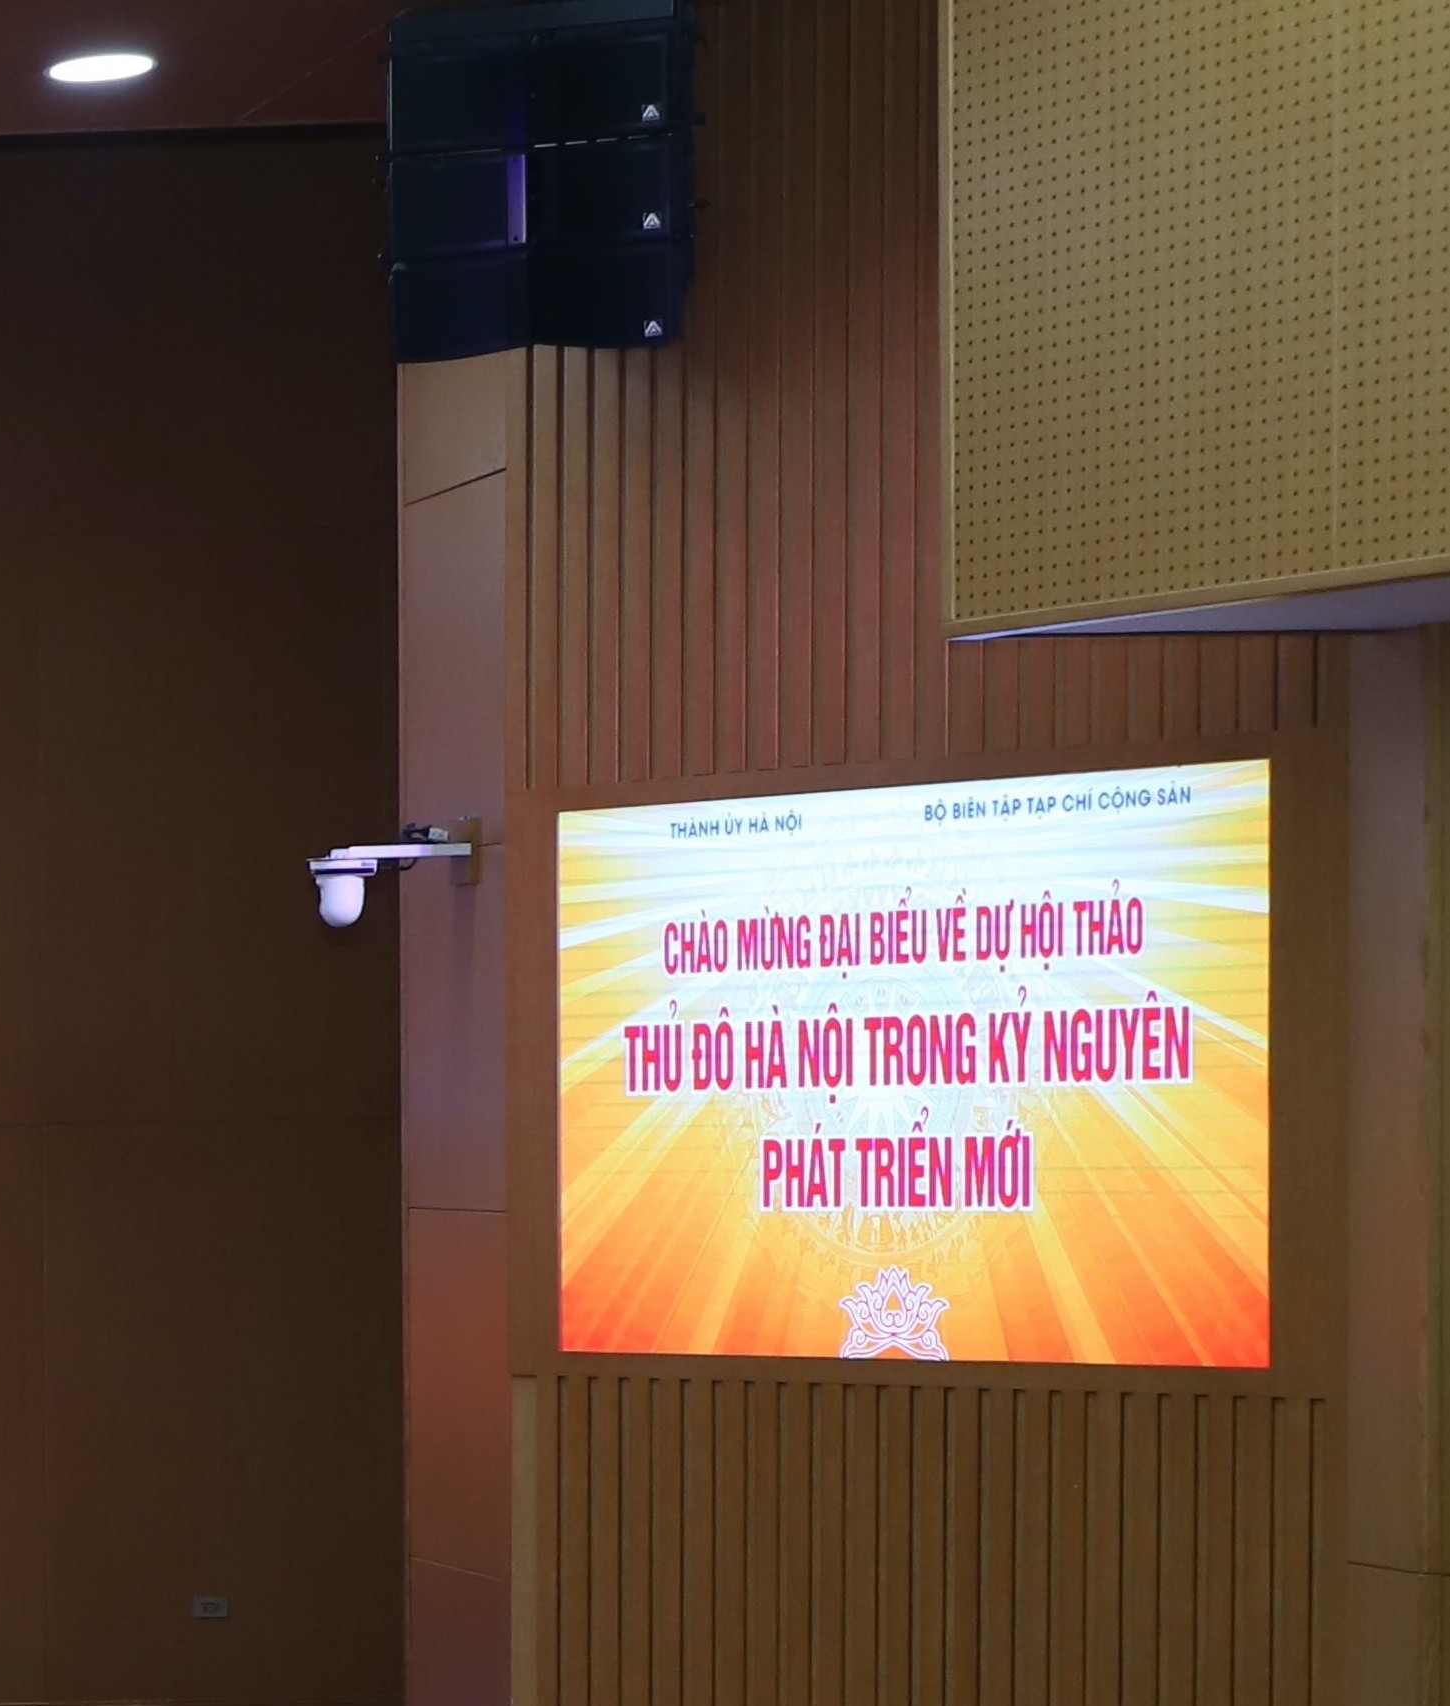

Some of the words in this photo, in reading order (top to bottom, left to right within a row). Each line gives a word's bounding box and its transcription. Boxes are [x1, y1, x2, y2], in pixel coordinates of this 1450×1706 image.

[670, 817, 720, 839] THÀNH
[724, 815, 744, 837] ỦY
[749, 812, 770, 835] HÀ
[774, 812, 802, 837] NỘI
[925, 798, 948, 825] BỘ
[952, 797, 987, 820] BIÊN
[992, 793, 1022, 820] TẬP
[1026, 794, 1057, 818] TẠP
[1063, 787, 1093, 812] CHÍ
[1098, 786, 1150, 814] CỘNG
[1156, 782, 1191, 807] SẢN
[664, 908, 728, 975] CHÀO
[737, 905, 810, 971] MỪNG
[819, 912, 860, 979] ĐẠI
[870, 886, 928, 964] BIỂU
[935, 888, 966, 960] VỀ
[977, 901, 1014, 972] DỰ
[1021, 890, 1063, 968] HỘI
[1073, 878, 1143, 956] THẢO
[625, 1000, 681, 1092] THỦ
[691, 1010, 734, 1090] ĐÔ
[746, 1004, 788, 1089] HÀ
[798, 1003, 853, 1104] NỘI
[865, 1015, 976, 1086] TRONG
[989, 986, 1032, 1084] KỶ
[1047, 991, 1191, 1082] NGUYÊN
[762, 1123, 844, 1208] PHÁT
[856, 1107, 951, 1207] TRIỂN
[964, 1119, 1031, 1208] MỚI
